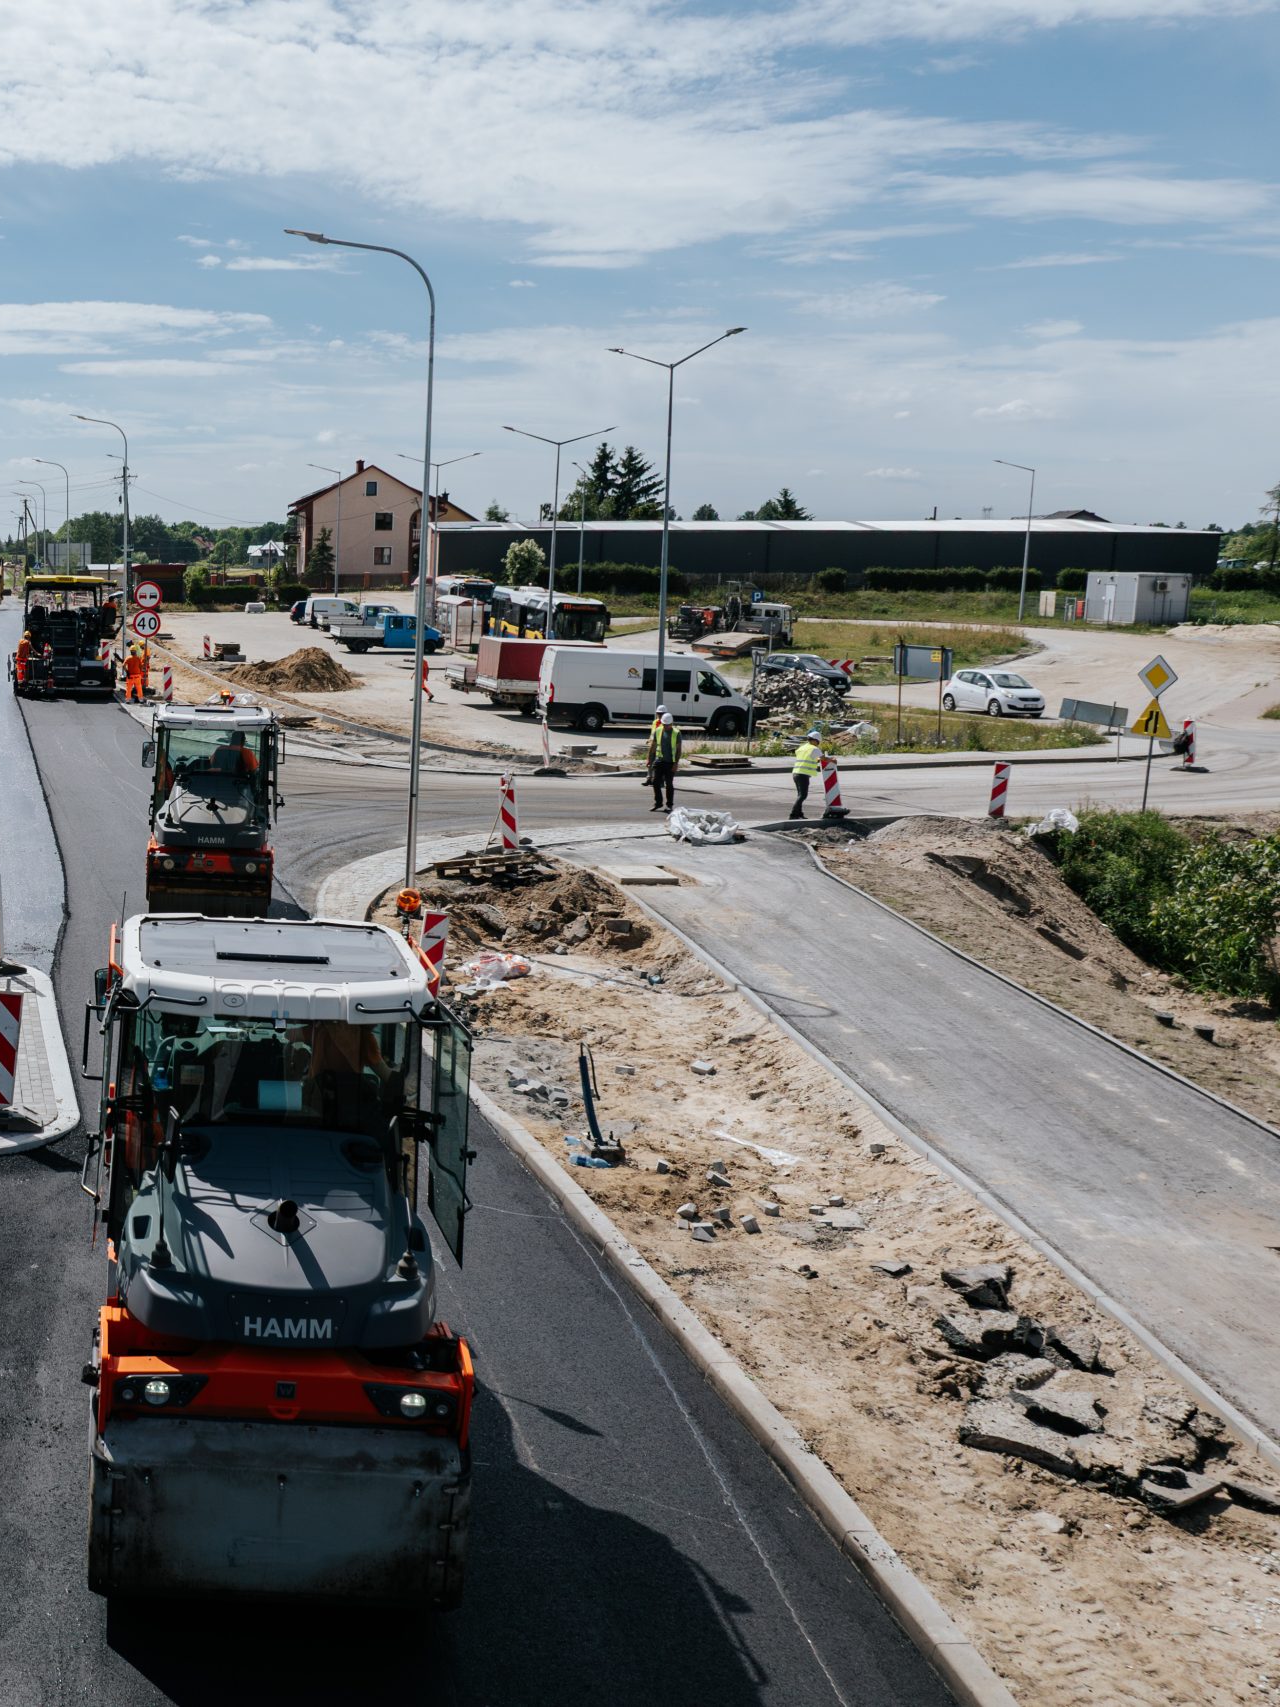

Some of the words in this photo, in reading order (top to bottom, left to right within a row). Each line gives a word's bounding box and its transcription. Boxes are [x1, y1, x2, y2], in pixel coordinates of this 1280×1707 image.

[754, 592, 761, 602] P
[137, 616, 157, 630] 40
[197, 836, 225, 845] HAMM
[243, 1315, 333, 1339] HAMM
